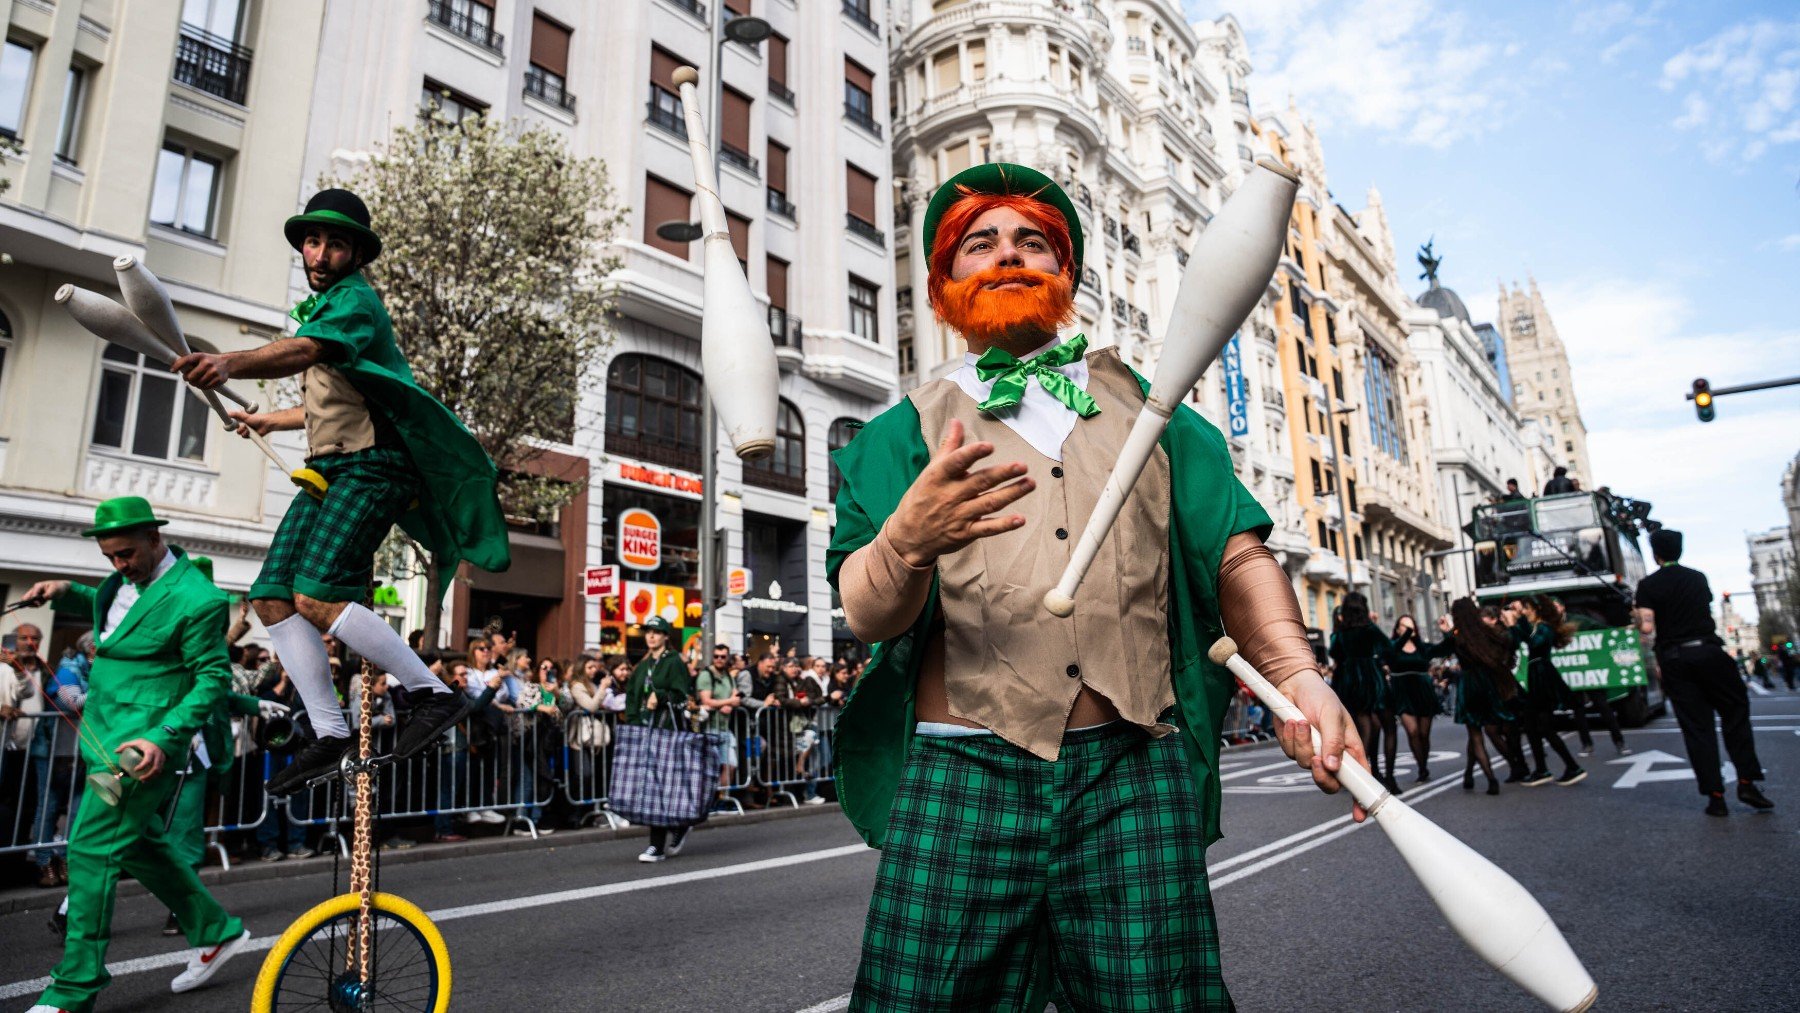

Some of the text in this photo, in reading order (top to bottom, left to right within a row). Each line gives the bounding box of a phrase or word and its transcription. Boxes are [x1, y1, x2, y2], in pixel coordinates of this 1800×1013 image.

[1226, 341, 1247, 432] ANTICO
[624, 527, 657, 541] BURGER
[624, 539, 657, 556] KING
[1551, 654, 1589, 668] OVER
